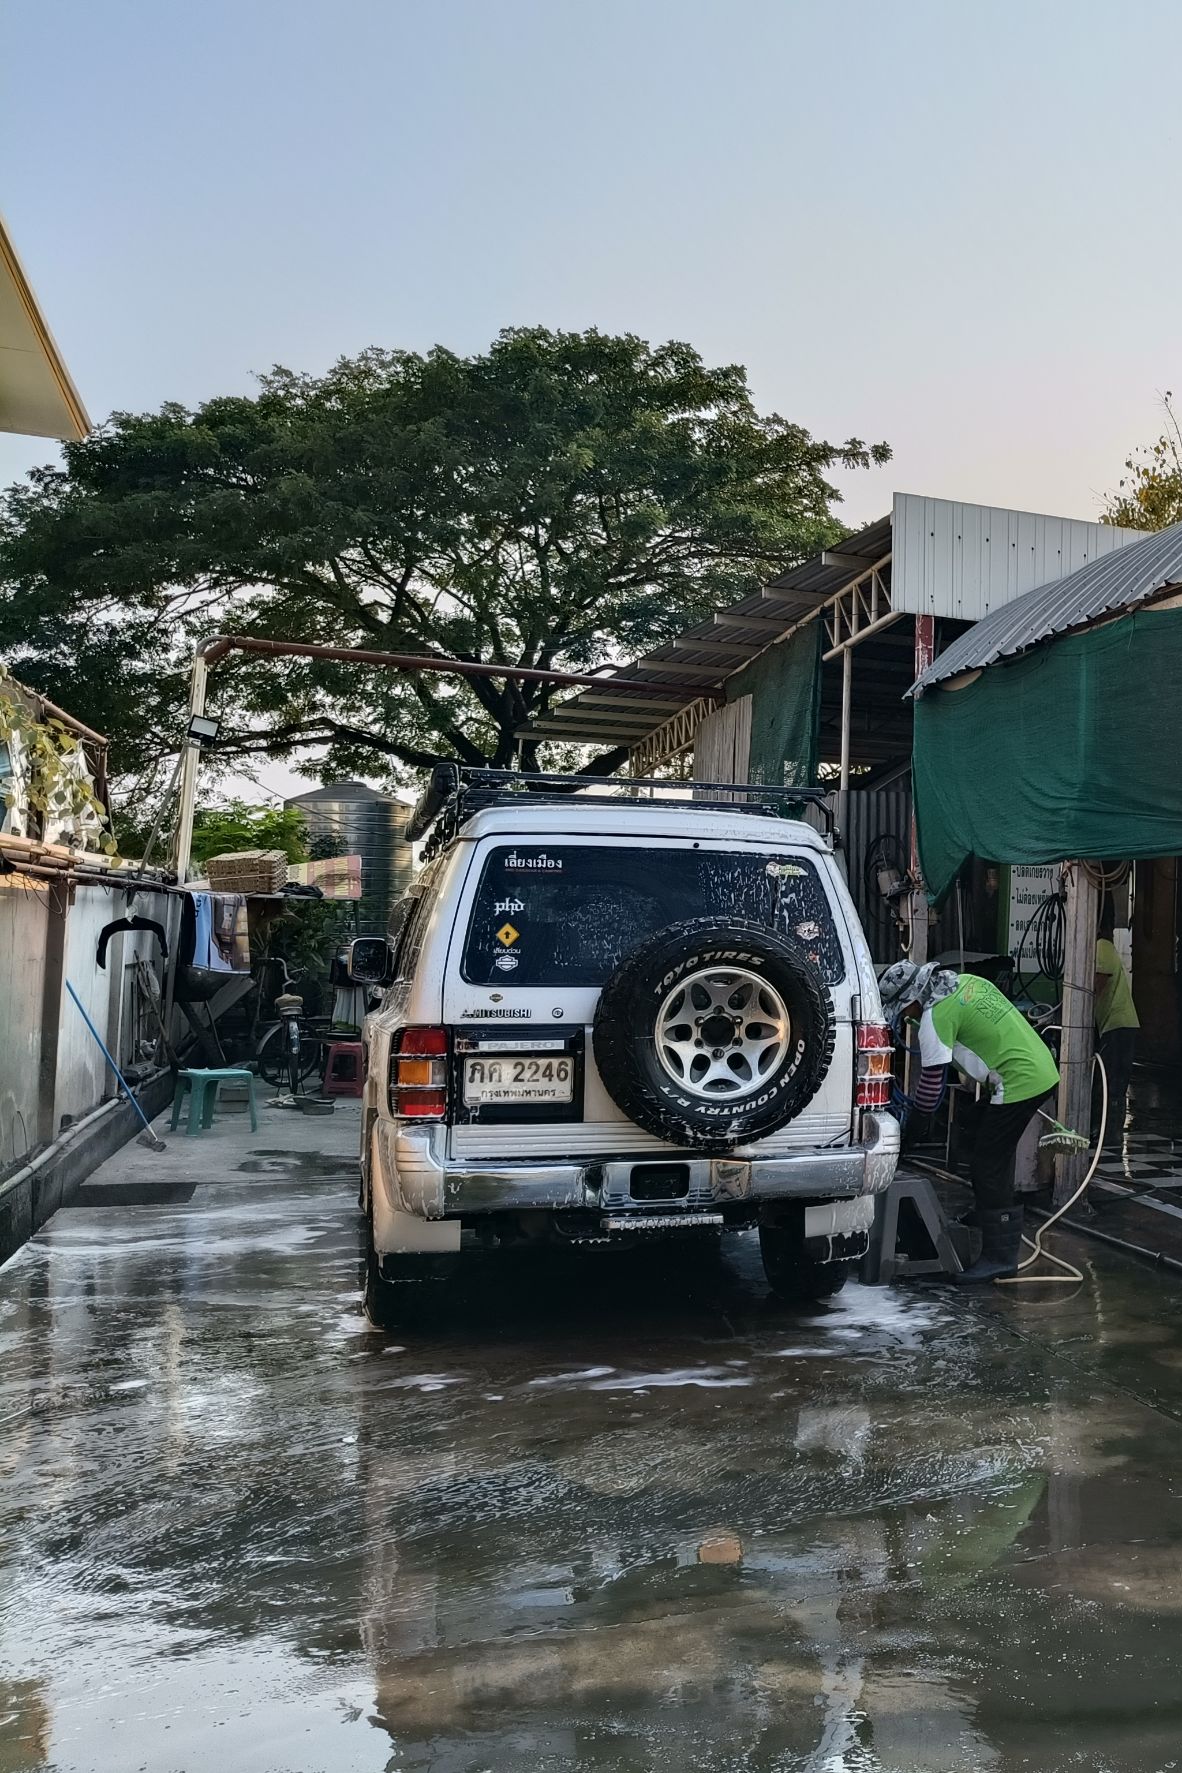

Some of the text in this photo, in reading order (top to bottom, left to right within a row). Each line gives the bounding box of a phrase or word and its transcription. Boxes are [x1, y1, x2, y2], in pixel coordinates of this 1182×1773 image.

[504, 850, 562, 869] เลี่ยงเมือง
[654, 951, 765, 995] TOYO TIRES
[472, 1008, 532, 1018] MITSUBISHI
[487, 1041, 555, 1050] PAJERO
[512, 1061, 569, 1082] 2246
[779, 1039, 805, 1087] OPEN
[481, 1087, 556, 1100] กรุงเทพมหานคร
[694, 1089, 778, 1115] COUNTRY
